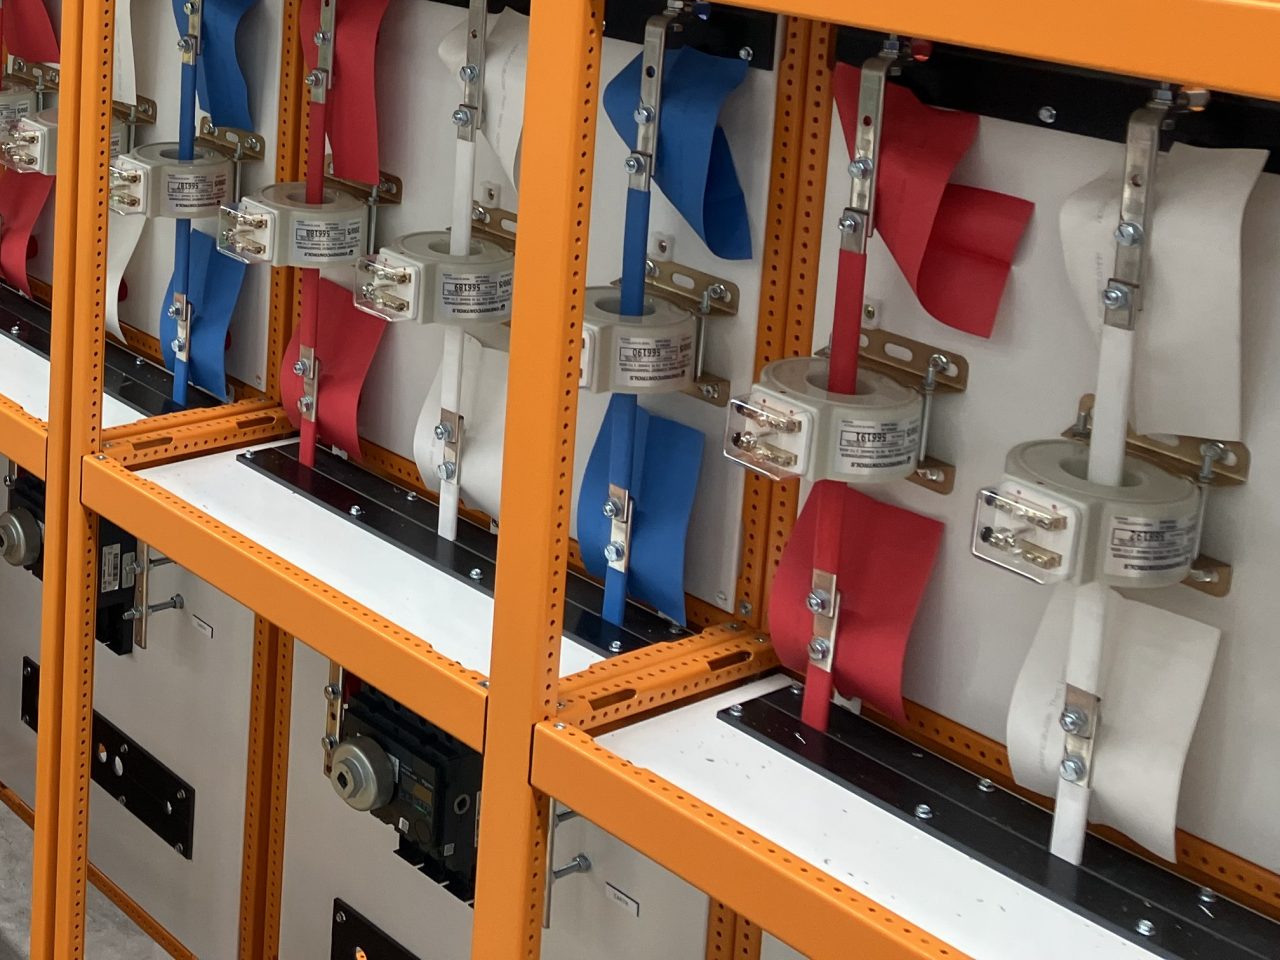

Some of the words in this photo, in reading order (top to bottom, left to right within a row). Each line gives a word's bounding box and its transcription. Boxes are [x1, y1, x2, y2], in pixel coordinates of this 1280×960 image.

[454, 283, 481, 292] 566189
[632, 348, 661, 358] 566190
[856, 432, 887, 443] 566191
